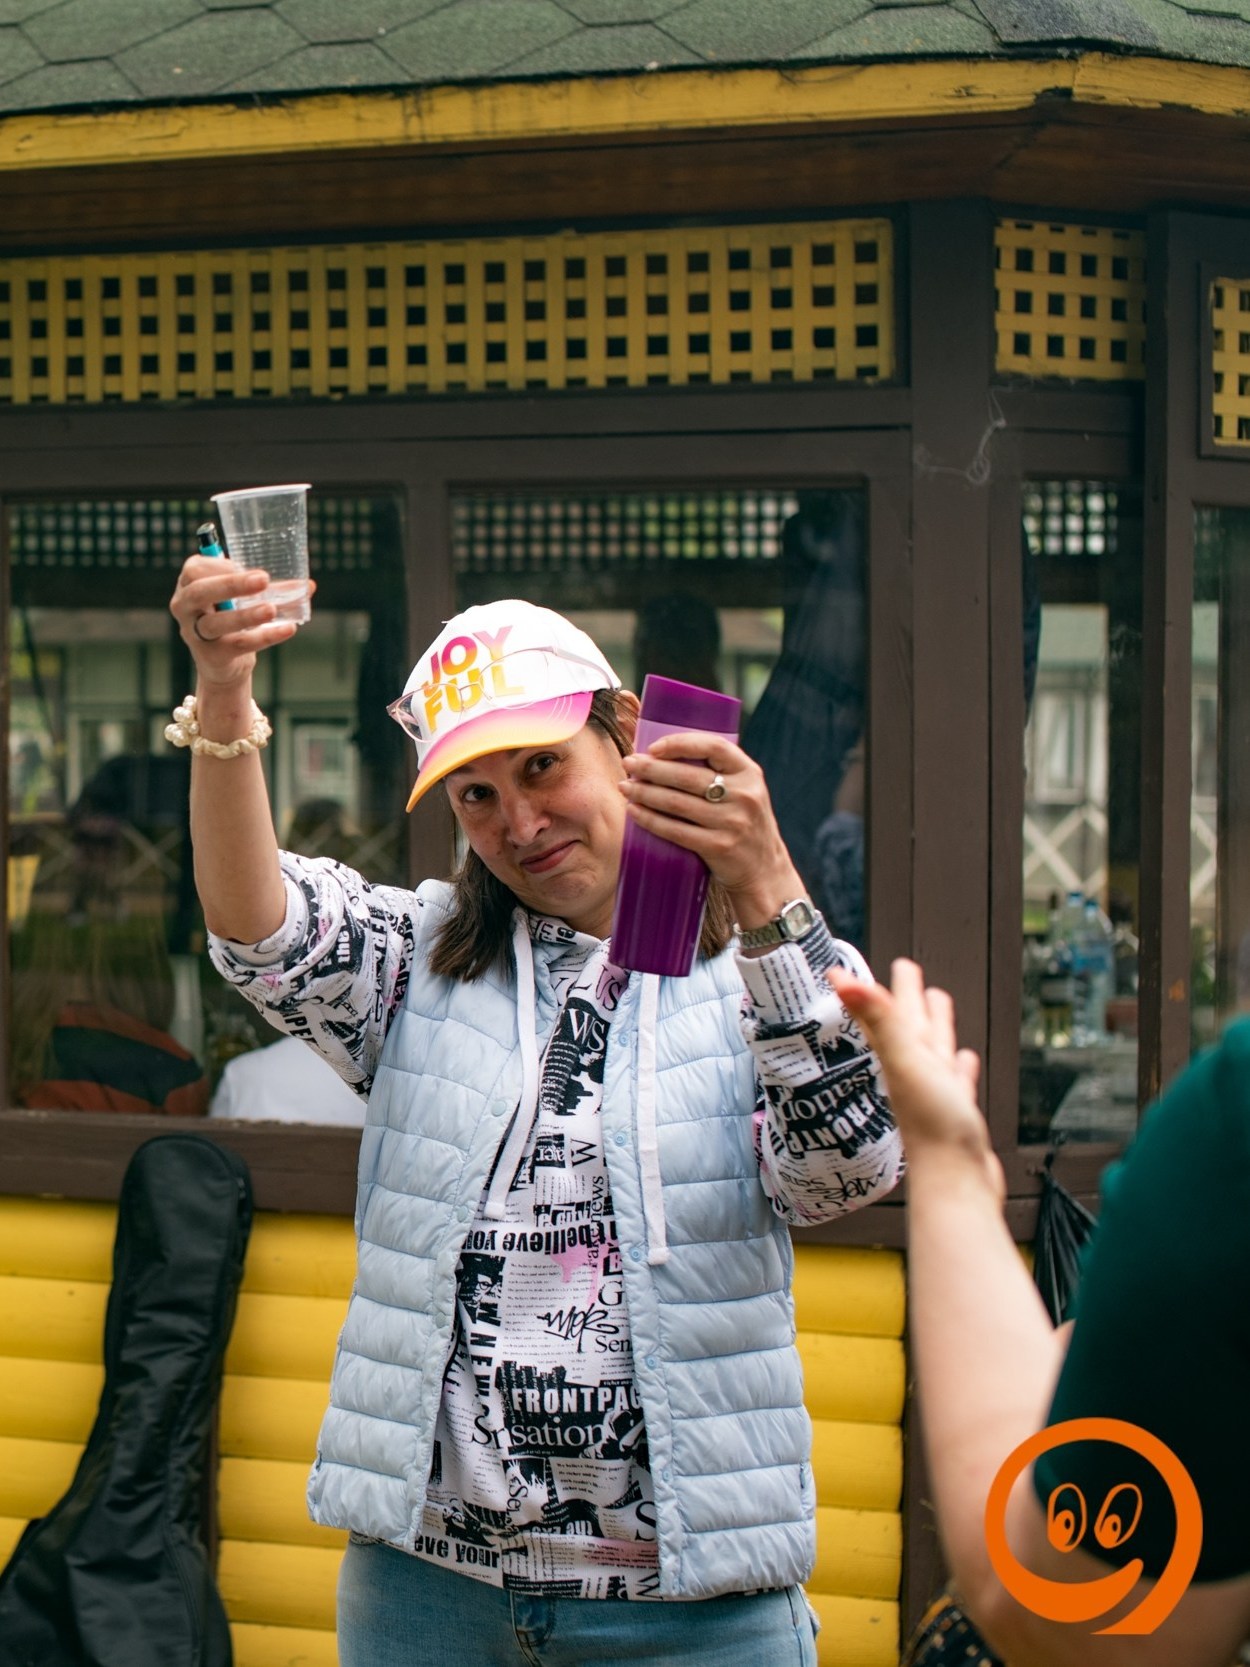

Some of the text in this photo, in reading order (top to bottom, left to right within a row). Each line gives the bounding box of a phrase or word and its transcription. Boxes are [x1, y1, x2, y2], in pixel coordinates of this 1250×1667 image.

[421, 625, 513, 698] JOY
[424, 664, 525, 734] FUL
[455, 1543, 499, 1568] your
